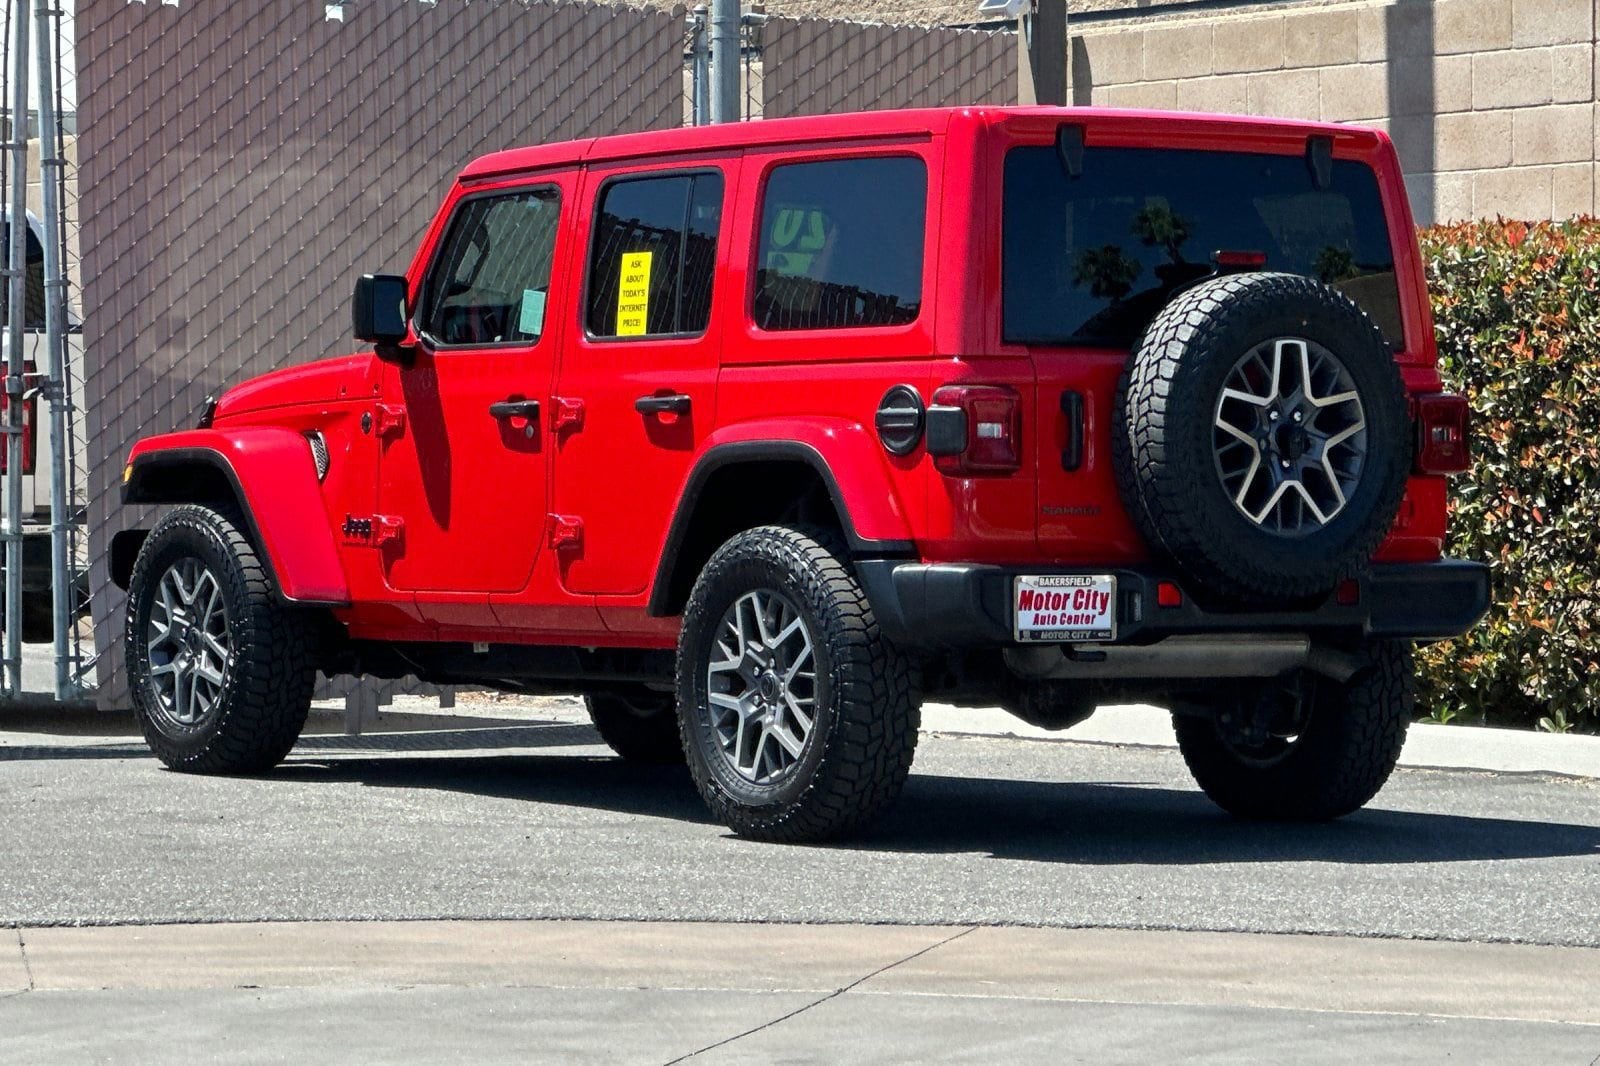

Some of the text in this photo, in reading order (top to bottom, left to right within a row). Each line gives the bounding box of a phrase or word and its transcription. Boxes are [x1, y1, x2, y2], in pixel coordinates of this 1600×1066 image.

[626, 275, 644, 283] ABOUT
[622, 289, 646, 297] TODAY'S
[619, 303, 647, 312] INTERNET
[341, 512, 372, 540] Jeep
[1039, 577, 1092, 586] BAKERSFIELD
[1018, 588, 1110, 616] Motor City
[1032, 613, 1096, 625] Auto Center
[1040, 631, 1070, 639] MOTOR
[1071, 631, 1091, 639] CITY
